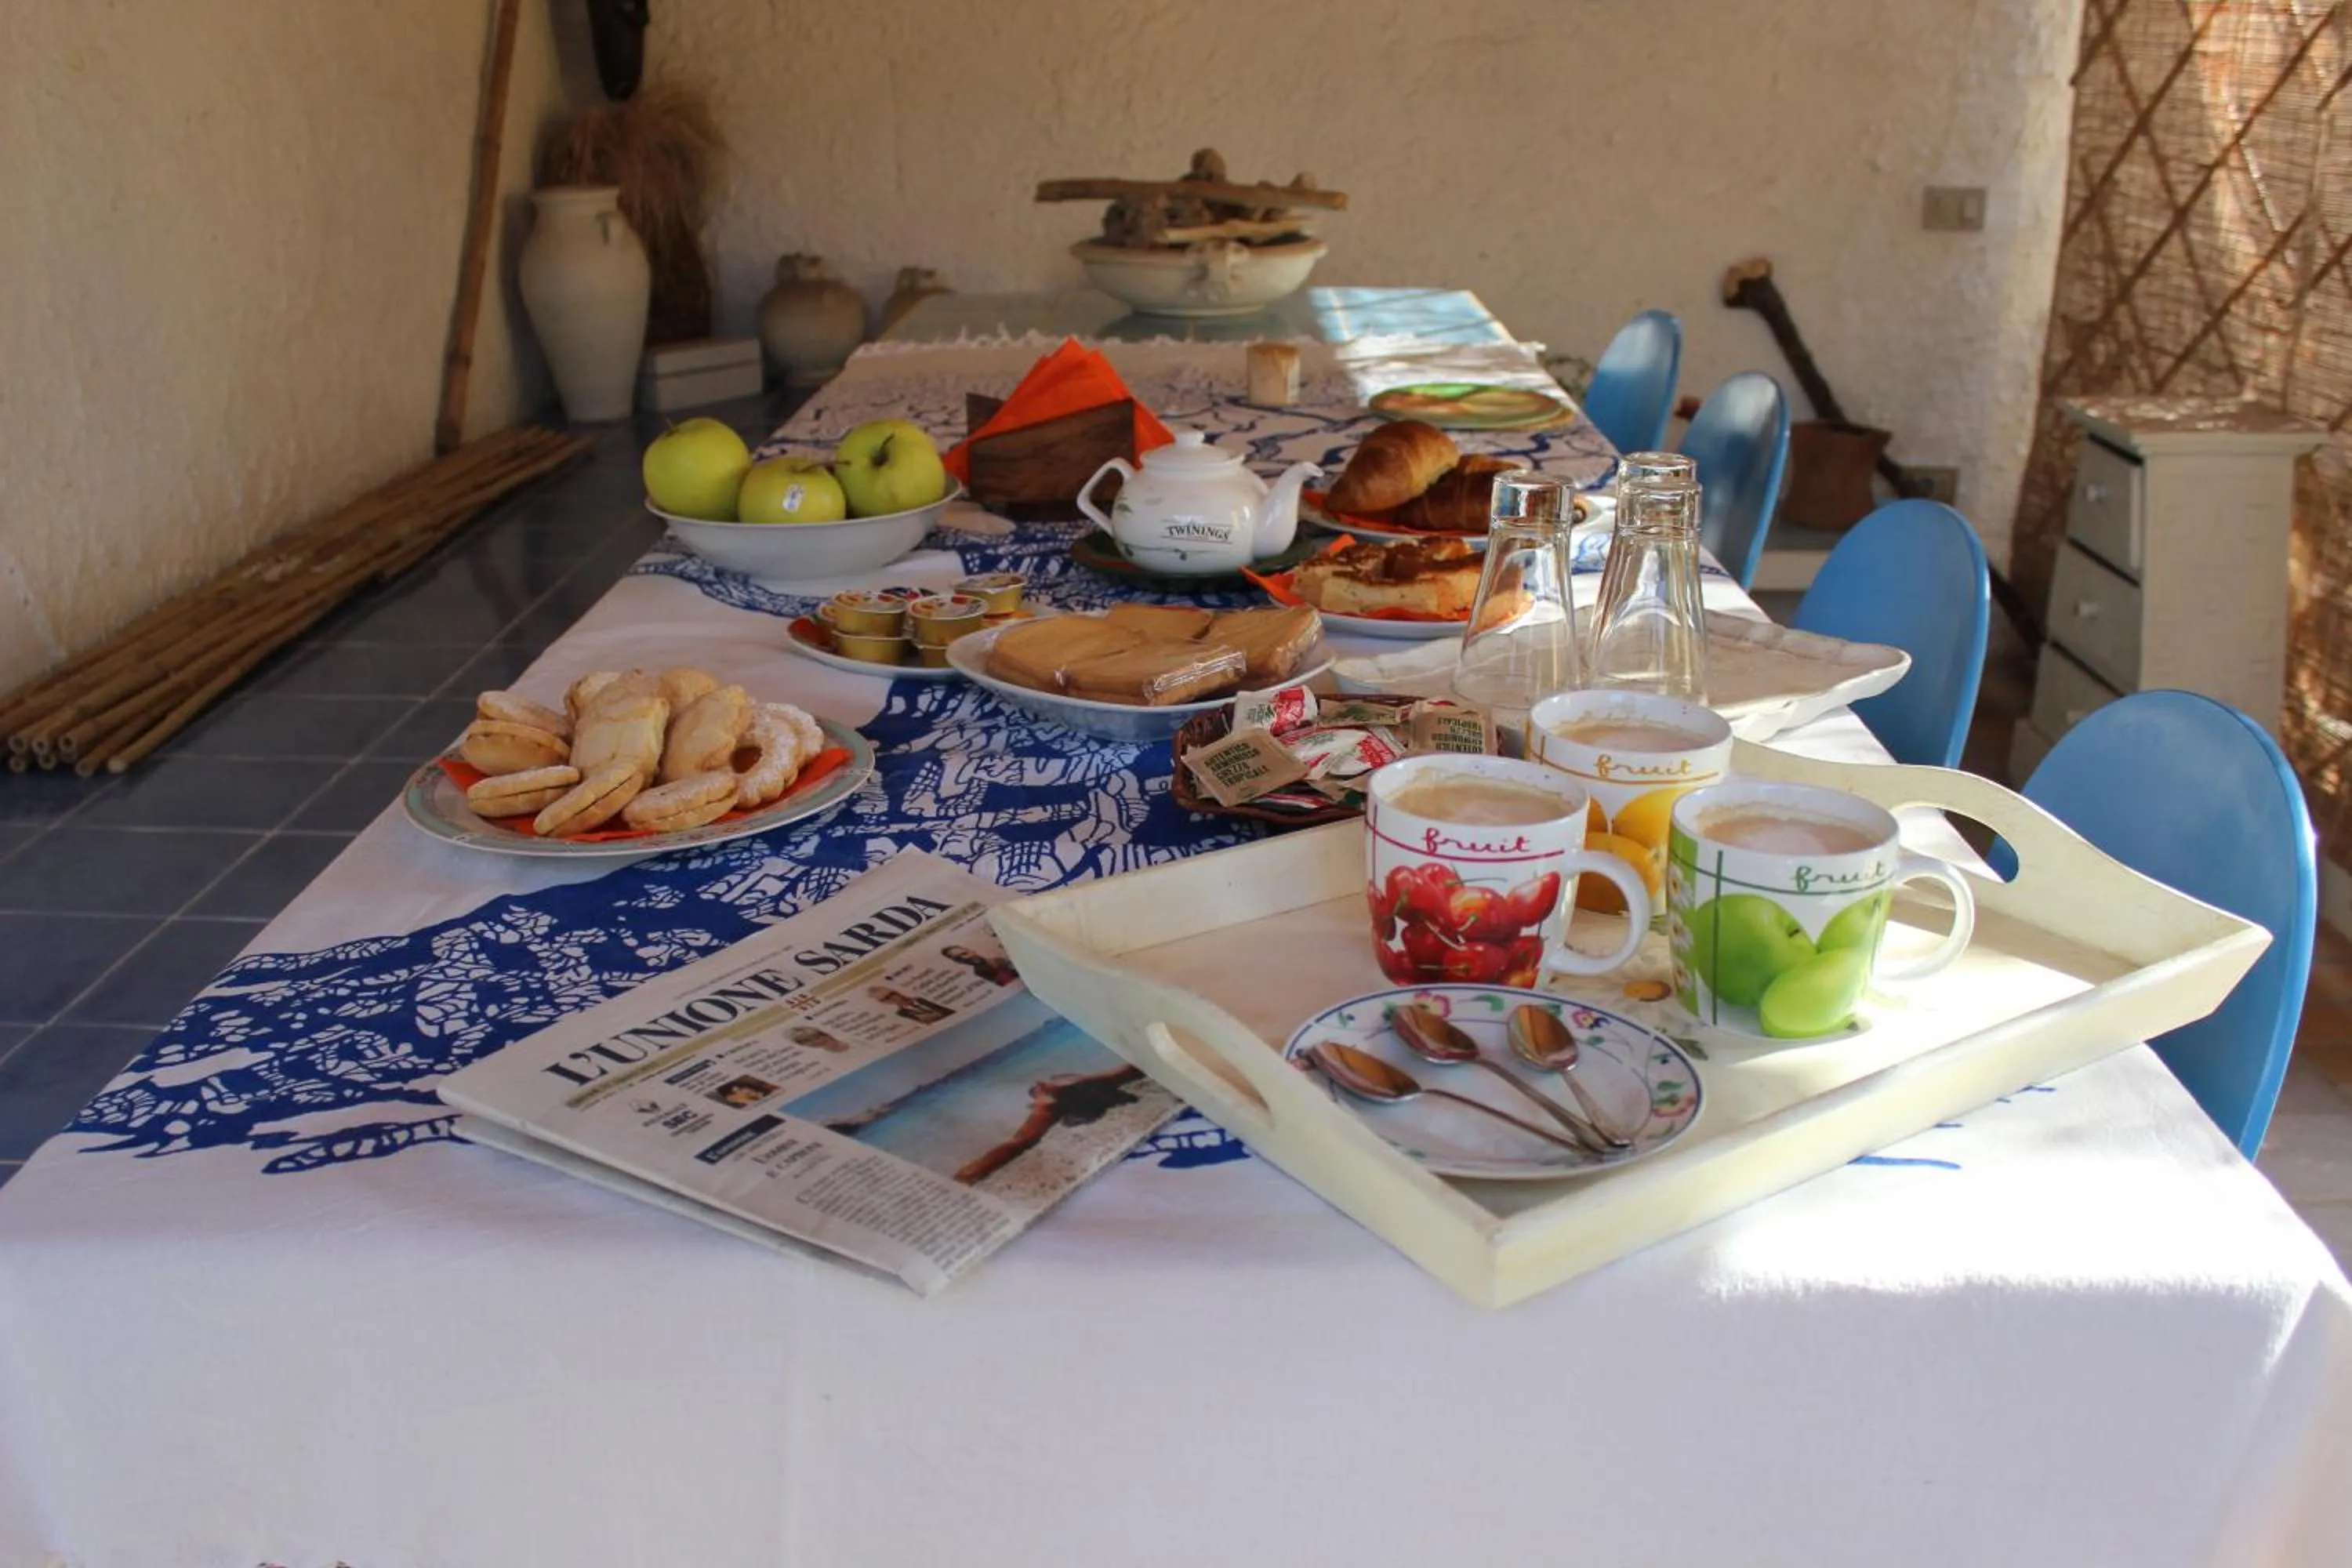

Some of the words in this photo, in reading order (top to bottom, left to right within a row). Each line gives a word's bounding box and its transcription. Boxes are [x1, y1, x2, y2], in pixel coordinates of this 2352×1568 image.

[1167, 524, 1232, 540] TWININGS
[1593, 753, 1691, 779] fruit
[1421, 827, 1531, 855] fruit
[1789, 861, 1884, 892] fruit
[546, 967, 805, 1087] L'UNIONE
[793, 895, 953, 975] SARDA
